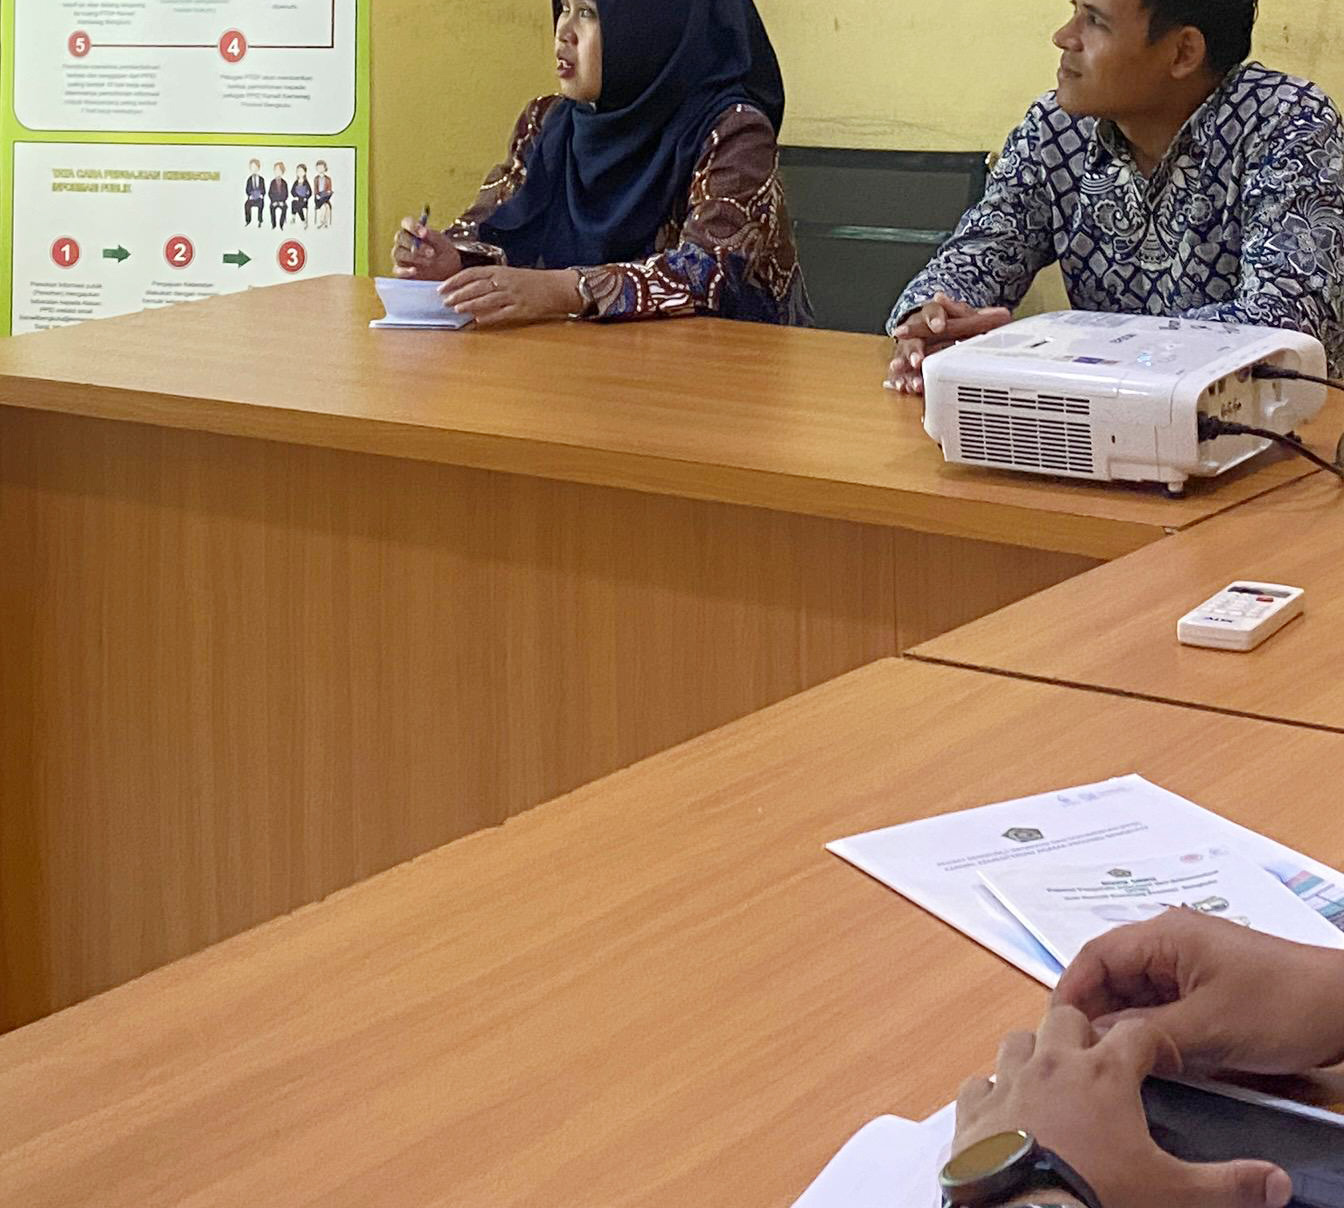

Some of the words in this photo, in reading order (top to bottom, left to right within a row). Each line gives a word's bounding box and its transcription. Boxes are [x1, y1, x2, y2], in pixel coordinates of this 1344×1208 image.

[75, 37, 86, 52] 5
[226, 37, 240, 57] 4
[61, 244, 71, 261] 1
[174, 243, 187, 261] 2
[286, 247, 298, 266] 3
